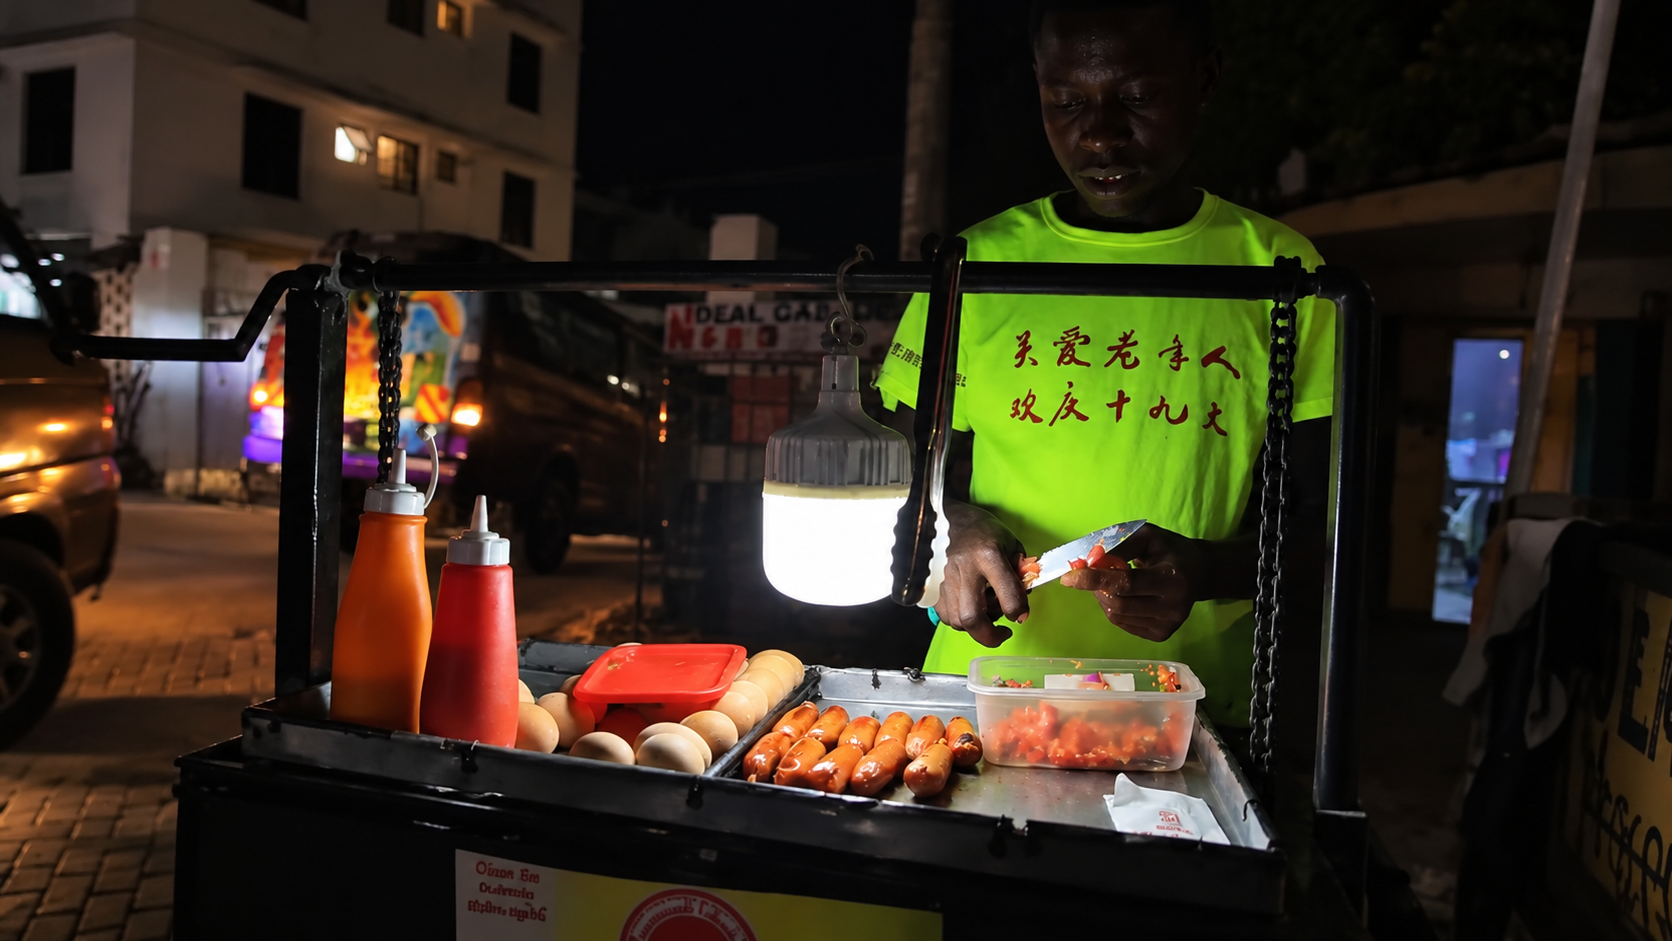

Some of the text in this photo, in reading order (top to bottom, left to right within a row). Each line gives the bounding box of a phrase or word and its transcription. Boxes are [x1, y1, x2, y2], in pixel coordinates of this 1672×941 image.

[1014, 325, 1241, 379] 关爱老年人
[1009, 381, 1228, 437] 欢庆十九大
